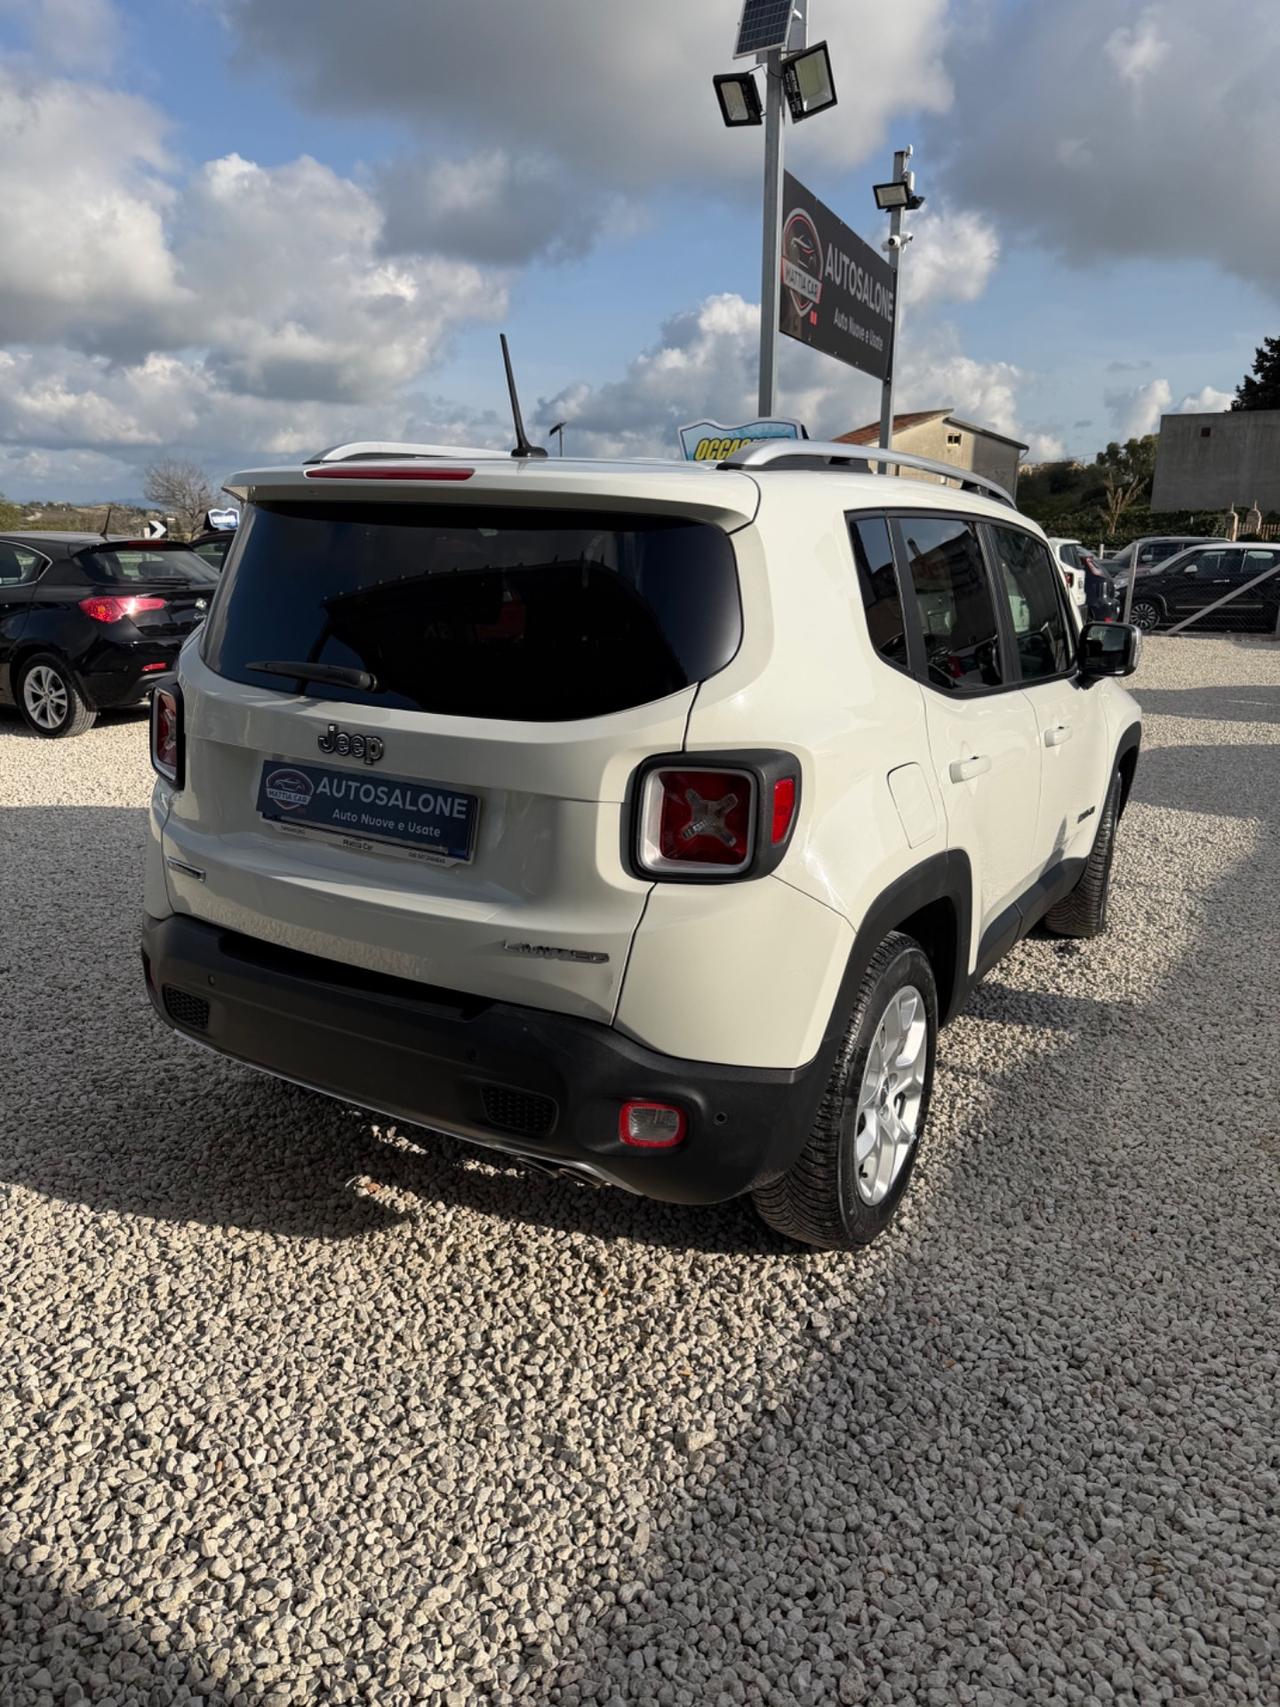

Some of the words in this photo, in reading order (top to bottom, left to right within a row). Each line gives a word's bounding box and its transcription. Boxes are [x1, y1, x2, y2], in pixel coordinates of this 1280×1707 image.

[824, 243, 894, 323] AUTOSALONE
[833, 307, 848, 331] Auto
[318, 724, 385, 765] Jeep
[316, 777, 468, 819] AUTOSALONE
[332, 808, 359, 823] Auto
[360, 812, 395, 830] Nuove
[398, 821, 405, 831] e
[408, 822, 441, 838] Usate
